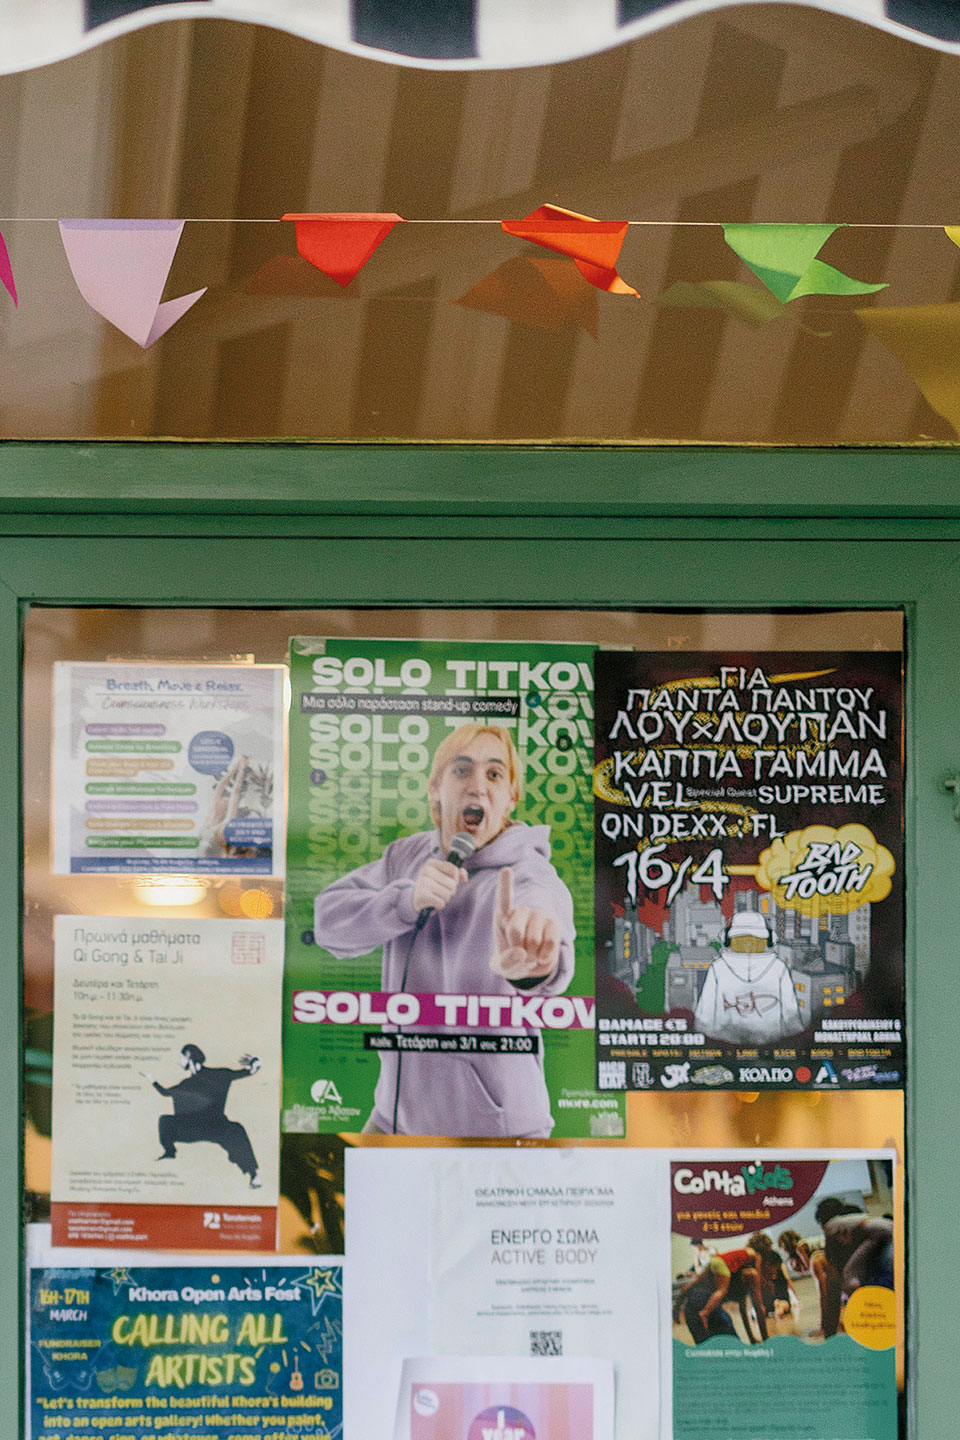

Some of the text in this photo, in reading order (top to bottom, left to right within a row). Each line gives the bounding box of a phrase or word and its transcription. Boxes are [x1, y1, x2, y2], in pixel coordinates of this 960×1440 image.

[311, 656, 431, 688] SOLO
[720, 666, 769, 690] ΓΙΑ
[422, 698, 471, 714] stand-up
[473, 699, 518, 714] comedy
[626, 687, 874, 715] ΠΑΝΤΑ ΠΑΝΤΟΥ
[309, 714, 429, 744] SOLO
[309, 743, 429, 771] SOLO
[613, 749, 744, 784] ΚΑΠΠΑ
[753, 748, 888, 782] ΓΑΜΜΑ
[623, 781, 700, 809] VEL
[758, 784, 886, 804] SUPREME
[601, 813, 644, 841] ON
[650, 813, 728, 840] DEXX
[752, 813, 788, 839] FL
[797, 841, 863, 872] BAD
[612, 842, 730, 909] 16/4
[777, 863, 874, 900] TOOTH
[74, 928, 202, 947] Πρωινά μαθήματα
[73, 948, 87, 962] Qi
[92, 949, 129, 966] Gong
[148, 949, 168, 964] Tai
[171, 949, 184, 964] Ji
[293, 990, 420, 1026] SOLO
[459, 1037, 477, 1049] 3/1
[491, 1229, 600, 1244] ΕΝΕΡΓΟ ΣΩΜΑ
[491, 1250, 598, 1265] ACTIVE BODY
[129, 1287, 301, 1305] Khora Open Arts Fest
[49, 1309, 88, 1322] MARCH
[112, 1313, 289, 1347] CALLING ALL
[144, 1353, 256, 1389] ARTISTS
[76, 1395, 143, 1409] transform
[145, 1395, 168, 1408] the
[169, 1395, 229, 1408] beautiful
[280, 1395, 333, 1410] building
[43, 1415, 71, 1428] into
[73, 1417, 89, 1427] an
[91, 1416, 123, 1429] open
[124, 1415, 152, 1427] arts
[205, 1413, 260, 1427] Whether
[262, 1416, 286, 1428] you
